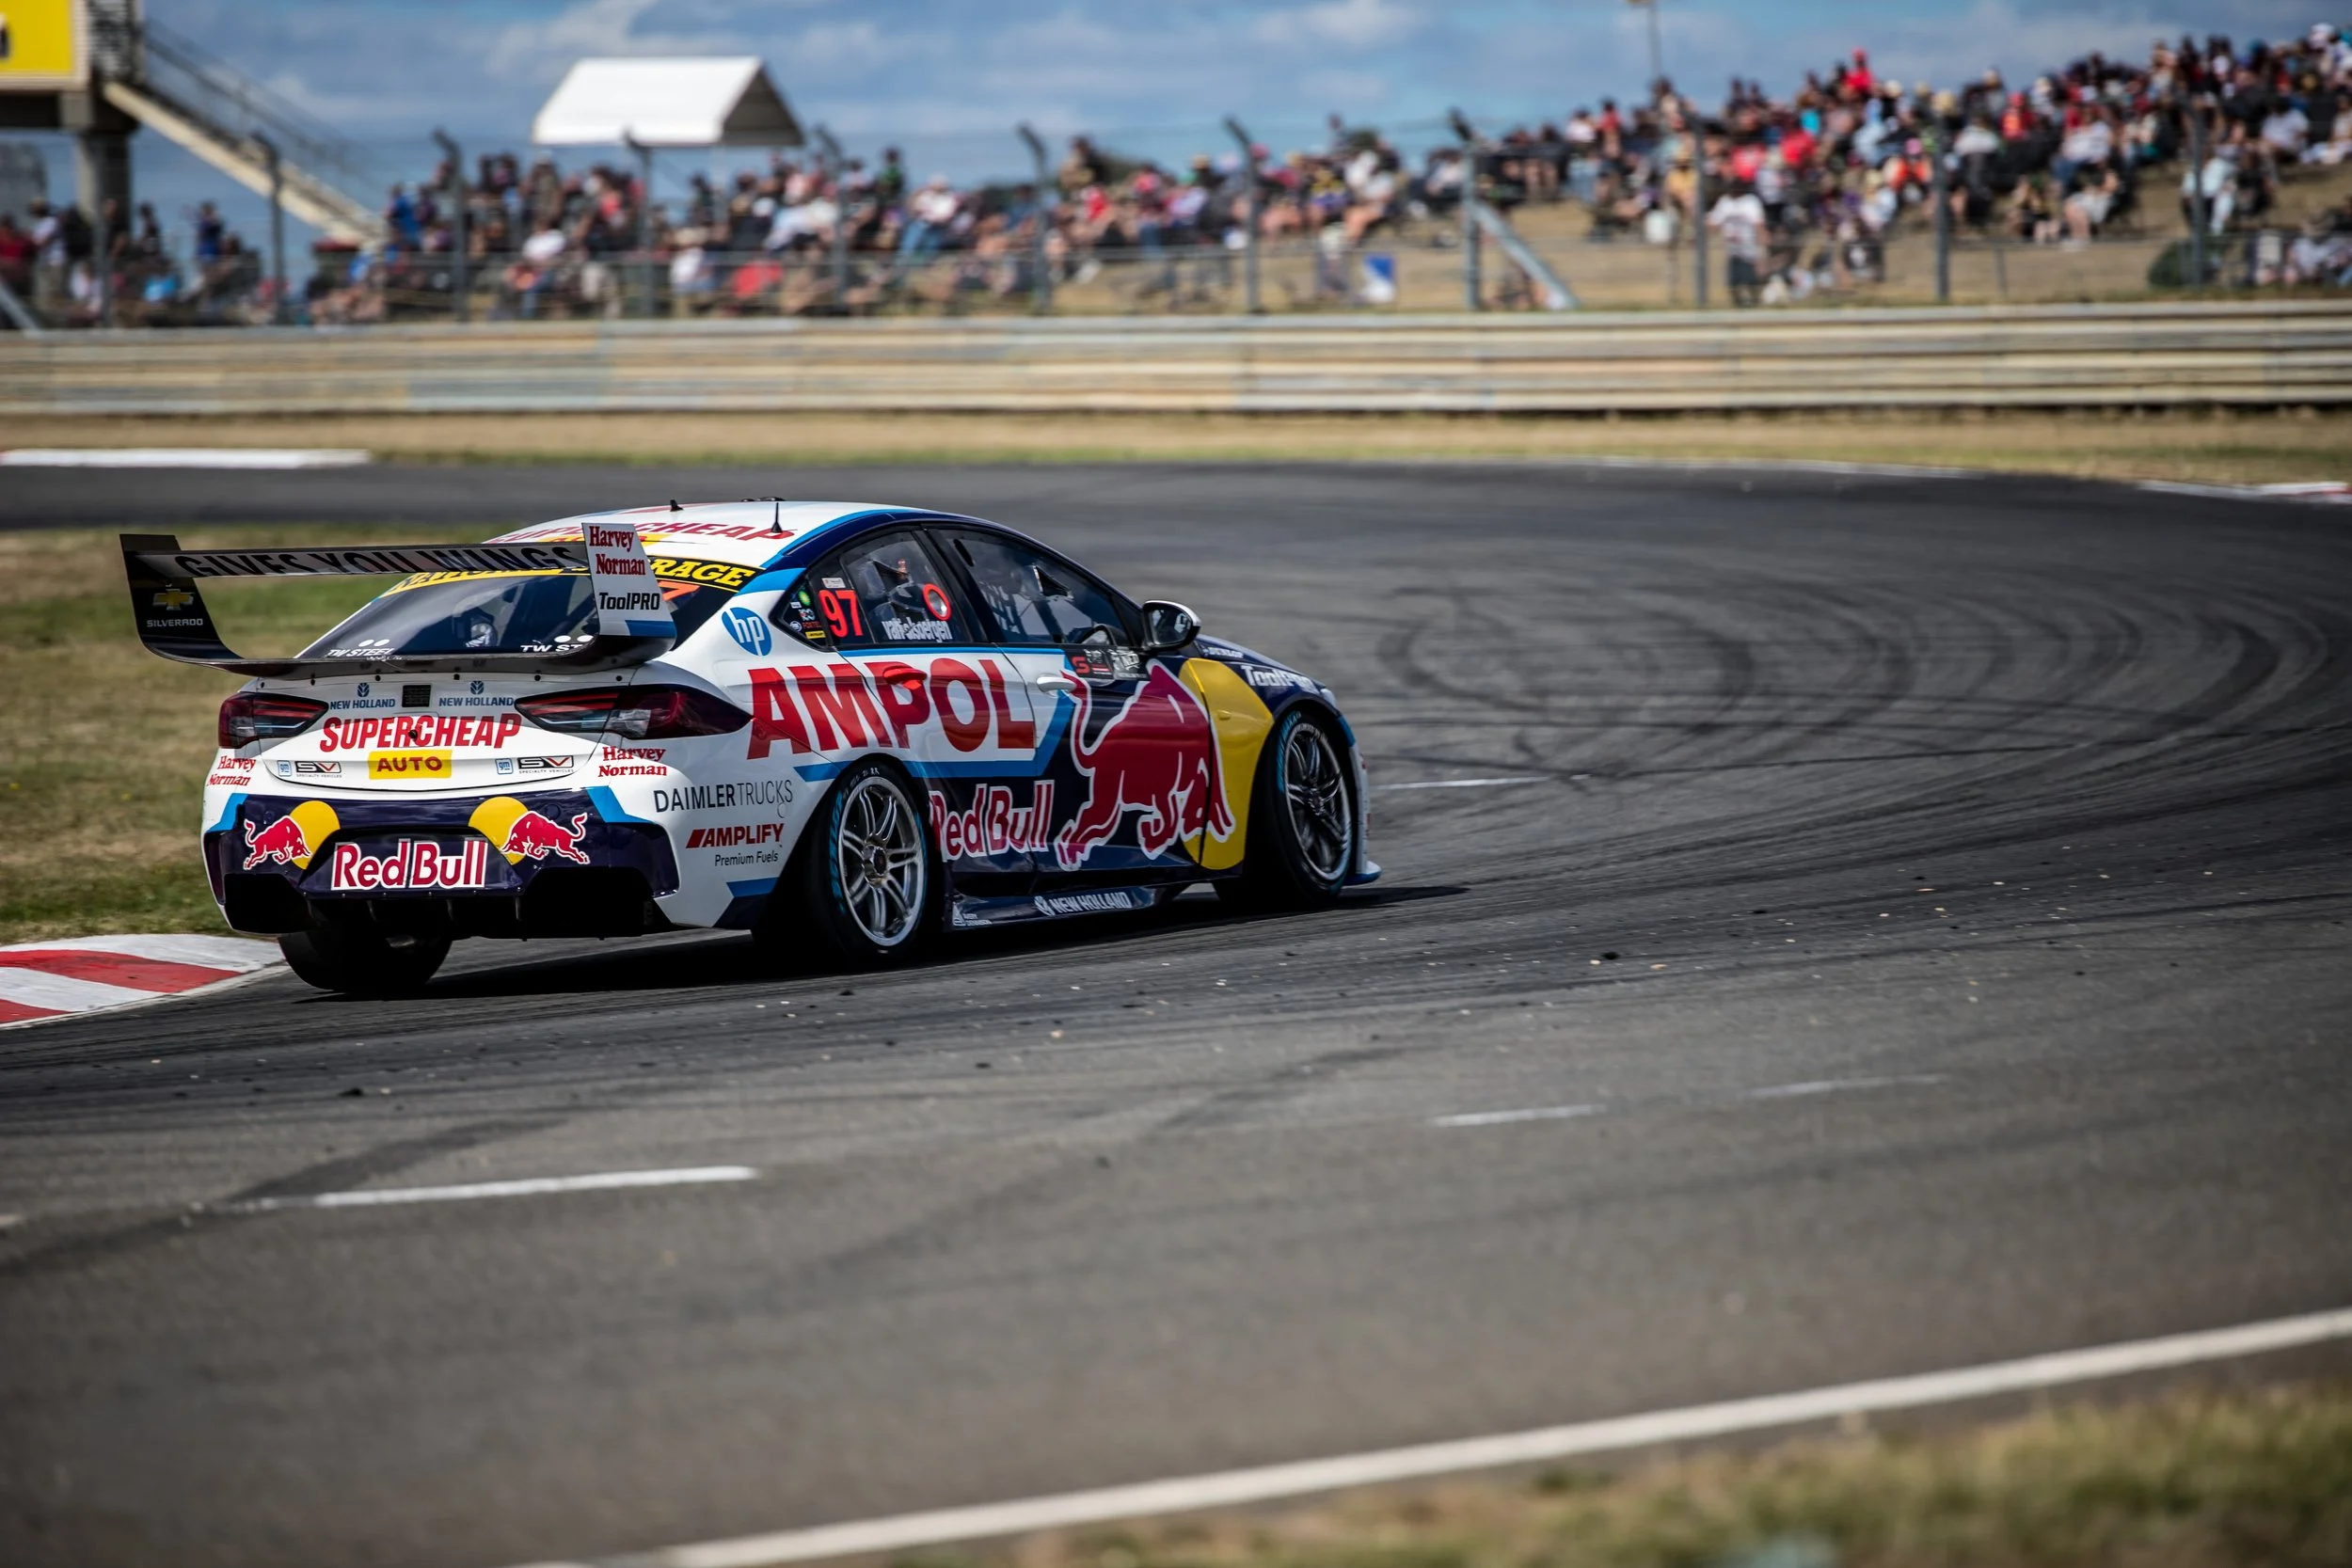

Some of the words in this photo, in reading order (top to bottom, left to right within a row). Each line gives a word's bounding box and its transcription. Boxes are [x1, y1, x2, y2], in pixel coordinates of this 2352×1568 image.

[589, 526, 634, 552] Harvey
[174, 553, 318, 578] GIVES
[307, 550, 423, 573] YOU
[416, 546, 587, 572] WINGS
[596, 553, 645, 576] Norman
[598, 592, 660, 610] ToolPRO
[818, 590, 863, 637] 97
[146, 618, 203, 627] SILVERADO
[730, 608, 766, 657] hp
[520, 644, 552, 653] TW
[329, 700, 351, 709] NEW
[352, 698, 396, 708] HOLLAND
[438, 697, 463, 706] NEW
[466, 697, 515, 706] HOLLAND
[747, 658, 1035, 760] AMPOL
[320, 713, 522, 752] SUPERCHEAP
[601, 746, 667, 762] Harvey
[217, 755, 256, 772] Harvey
[376, 756, 443, 772] AUTO
[598, 765, 667, 777] Norman
[207, 774, 251, 786] Norman
[701, 823, 785, 847] AMPLIFY
[714, 853, 754, 866] Premium
[755, 850, 779, 863] Fuels
[1049, 896, 1082, 913] NEW
[1081, 892, 1132, 911] HOLLAND
